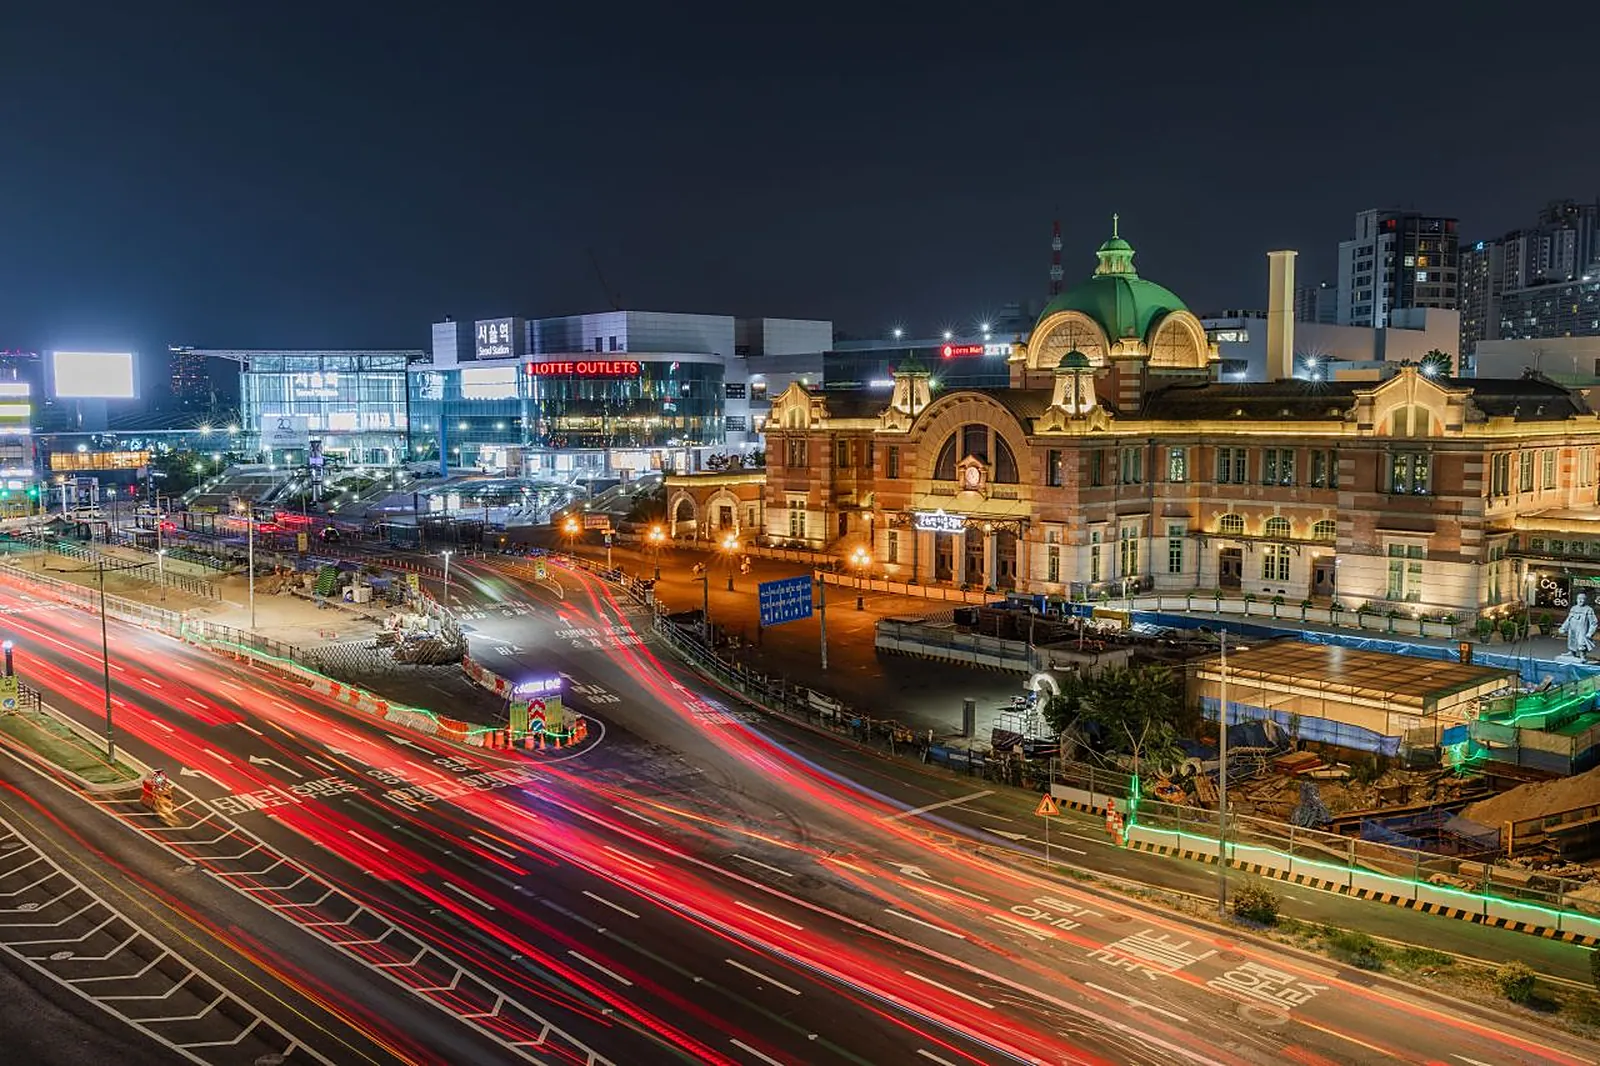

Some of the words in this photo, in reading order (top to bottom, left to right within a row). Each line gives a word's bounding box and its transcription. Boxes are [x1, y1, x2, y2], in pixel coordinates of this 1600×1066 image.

[478, 323, 509, 344] 서울역
[479, 346, 491, 356] Seoul
[535, 363, 573, 374] LOTTE
[576, 361, 638, 374] OUTLETS
[984, 896, 1104, 941] 서울역
[1086, 929, 1218, 981] 롯데마트
[1206, 961, 1330, 1012] 아울렛
